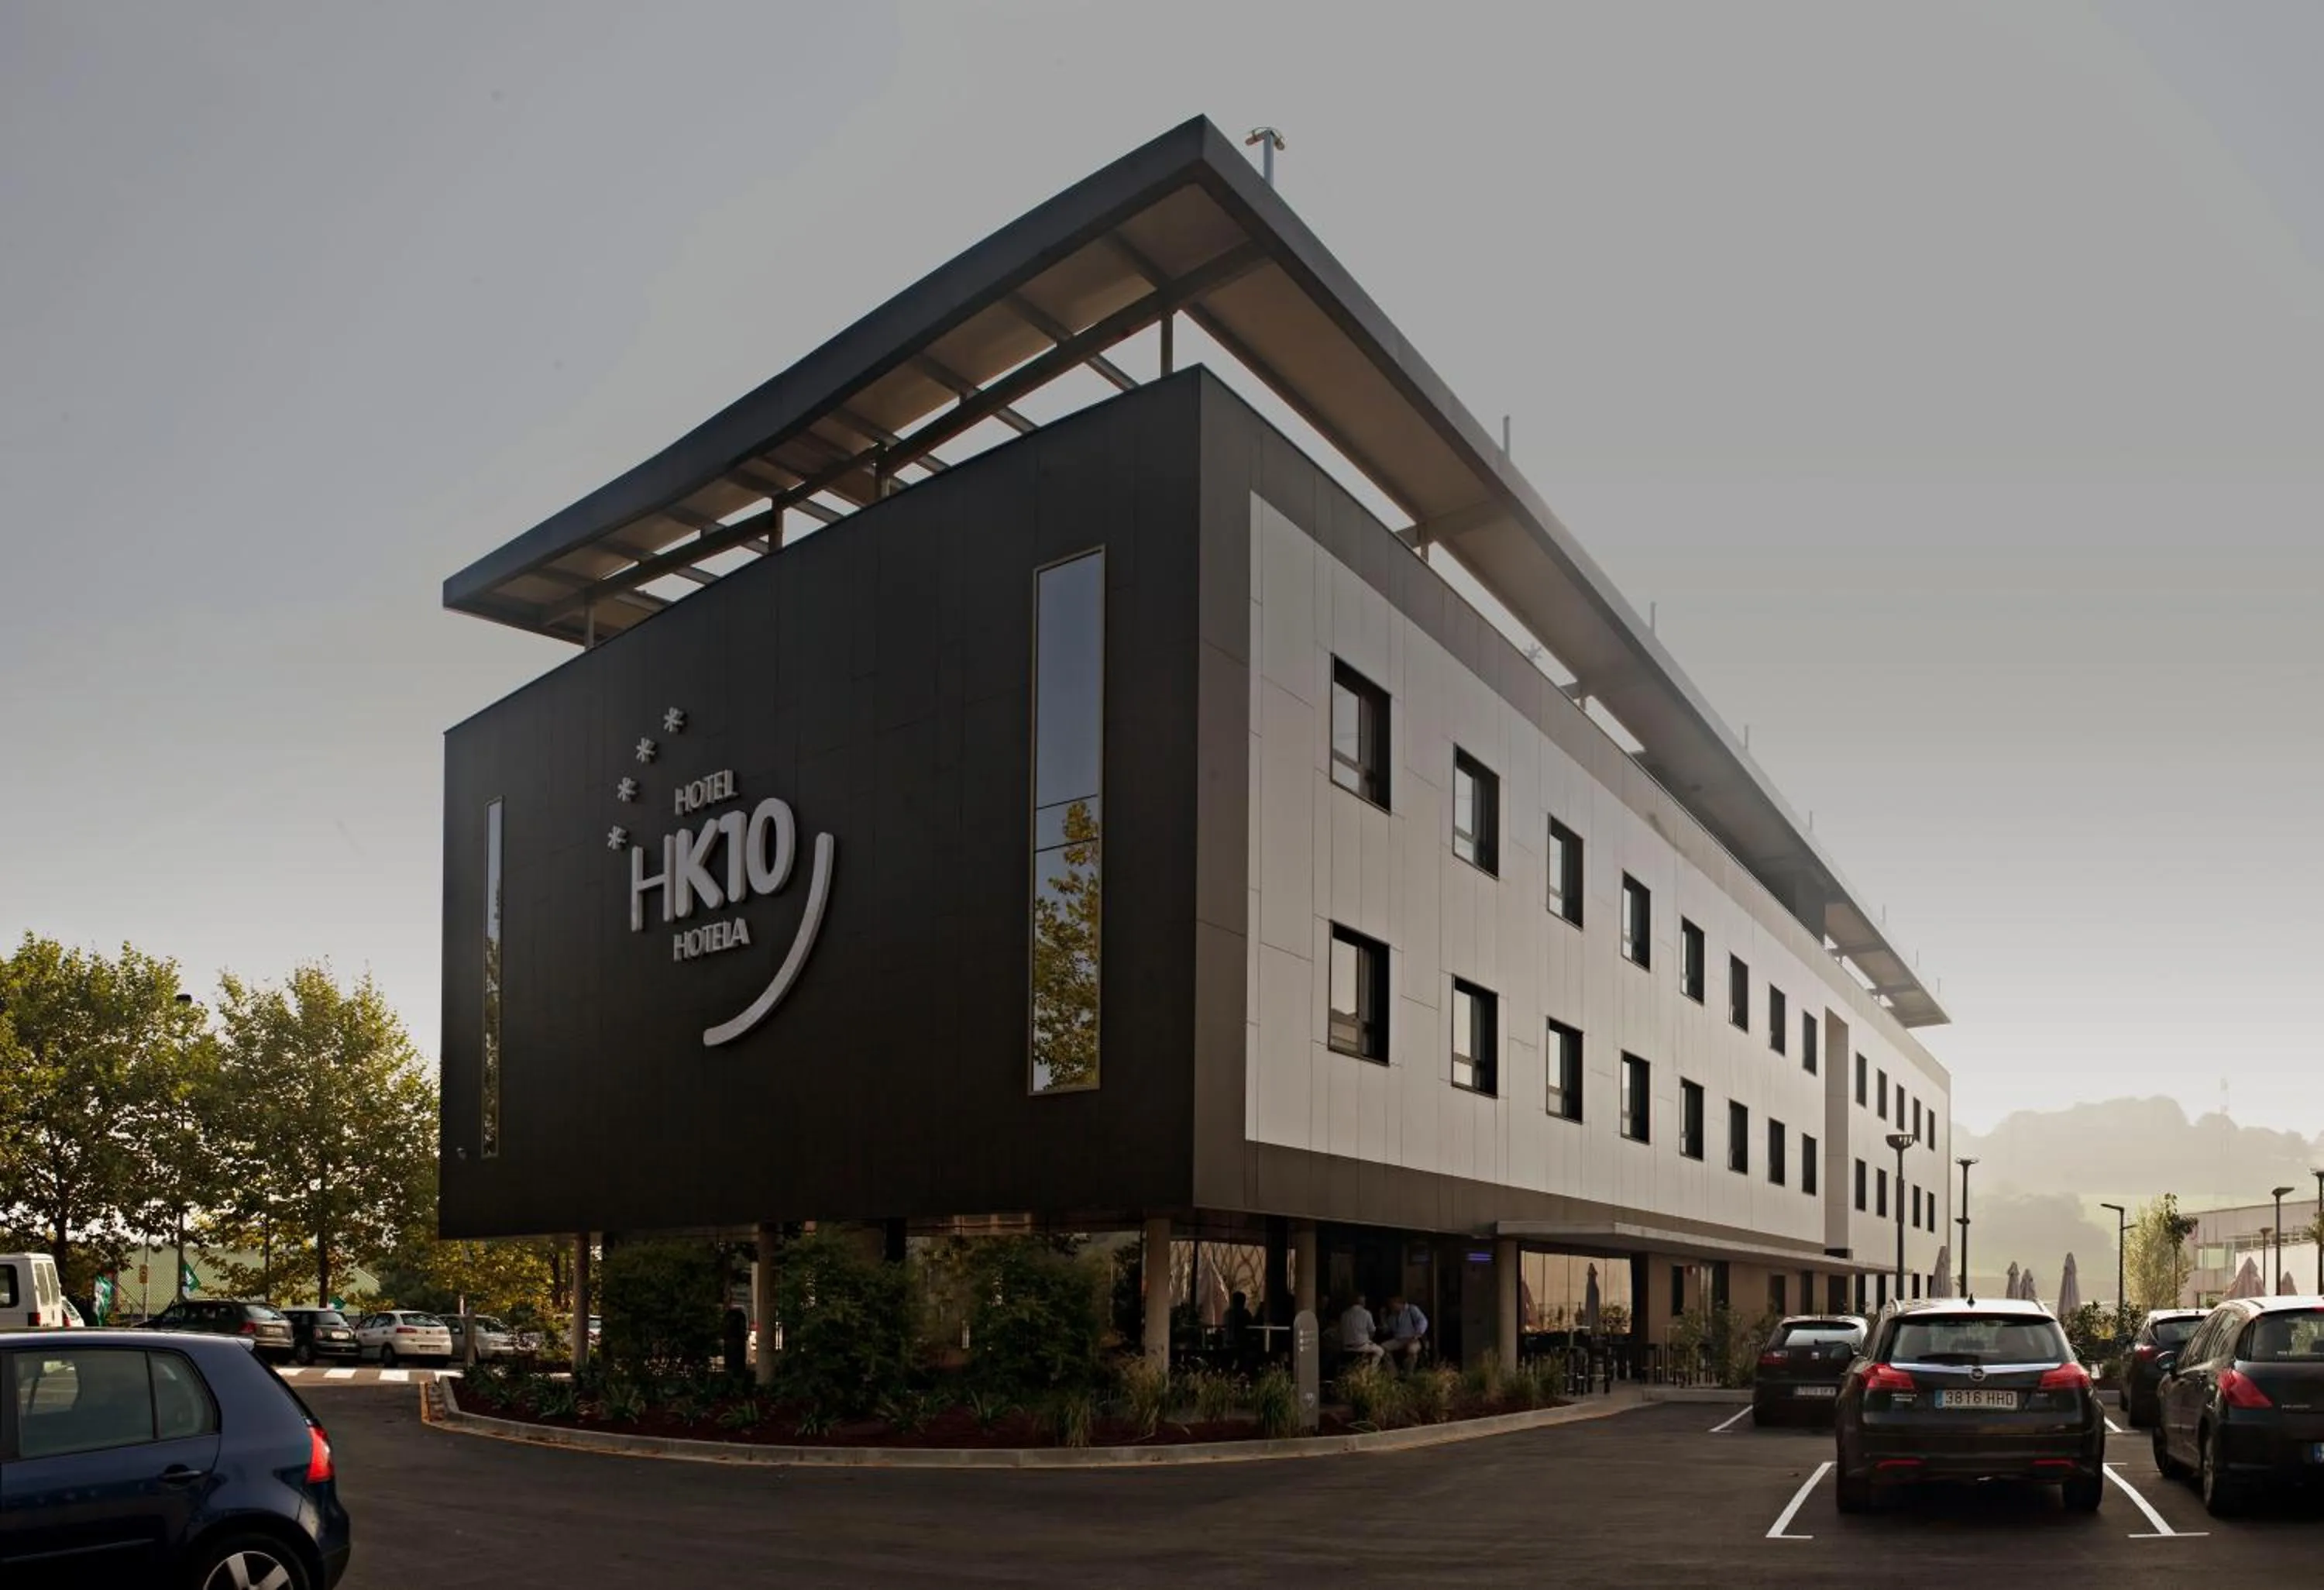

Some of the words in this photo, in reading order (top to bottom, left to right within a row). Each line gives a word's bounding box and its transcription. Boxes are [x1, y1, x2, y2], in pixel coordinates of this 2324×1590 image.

[675, 769, 739, 815] HOTEL
[631, 797, 795, 931] HK10
[674, 917, 750, 962] HOTELA
[1946, 1390, 1982, 1404] 3816
